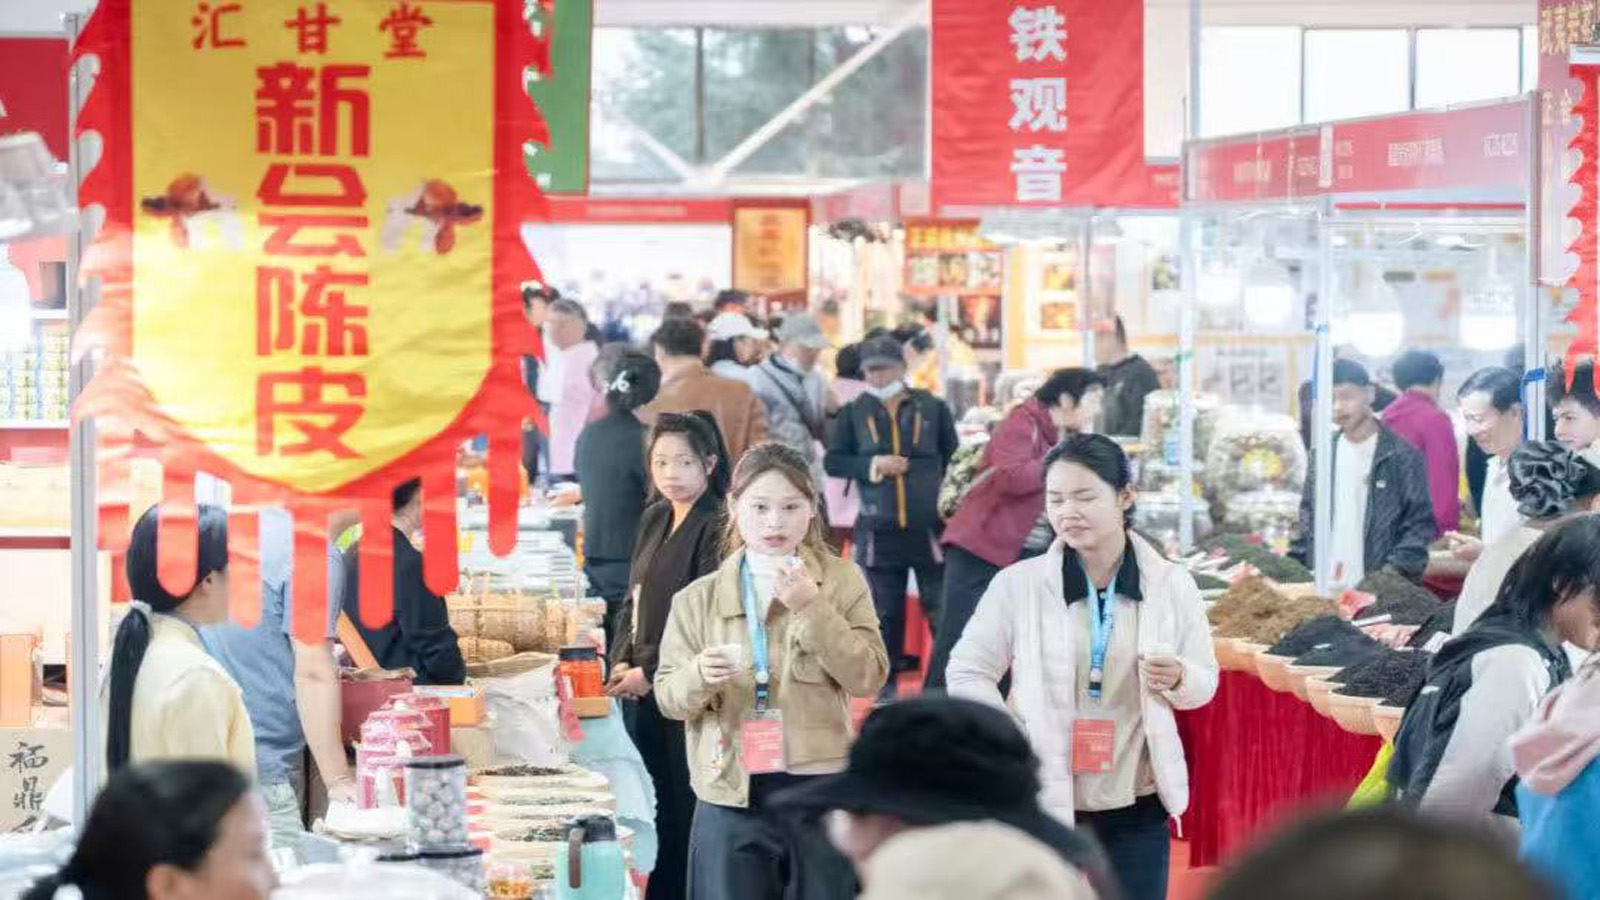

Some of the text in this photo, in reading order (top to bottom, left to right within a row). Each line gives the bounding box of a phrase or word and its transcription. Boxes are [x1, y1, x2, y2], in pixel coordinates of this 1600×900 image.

[191, 1, 433, 60] 汇甘堂
[1008, 5, 1067, 202] 铁观音
[254, 60, 371, 460] 新会陈皮
